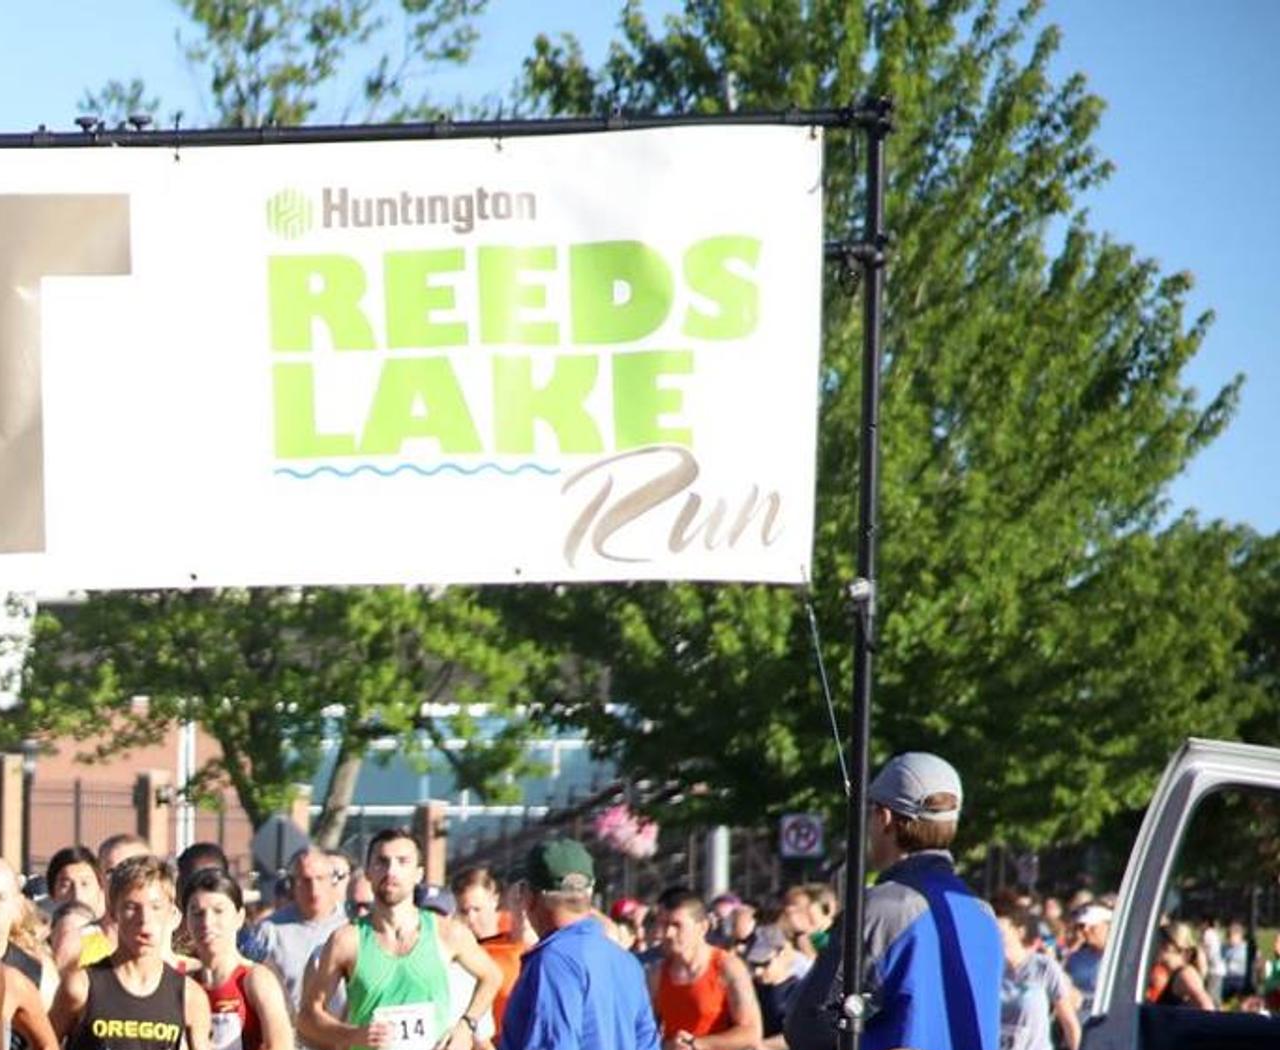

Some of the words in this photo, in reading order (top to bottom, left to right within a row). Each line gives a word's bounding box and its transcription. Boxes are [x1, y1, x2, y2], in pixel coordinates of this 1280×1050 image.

[321, 187, 537, 235] Huntington
[266, 234, 763, 352] REEDS
[271, 350, 696, 460] LAKE
[560, 444, 784, 569] Run
[92, 1019, 181, 1043] OREGON
